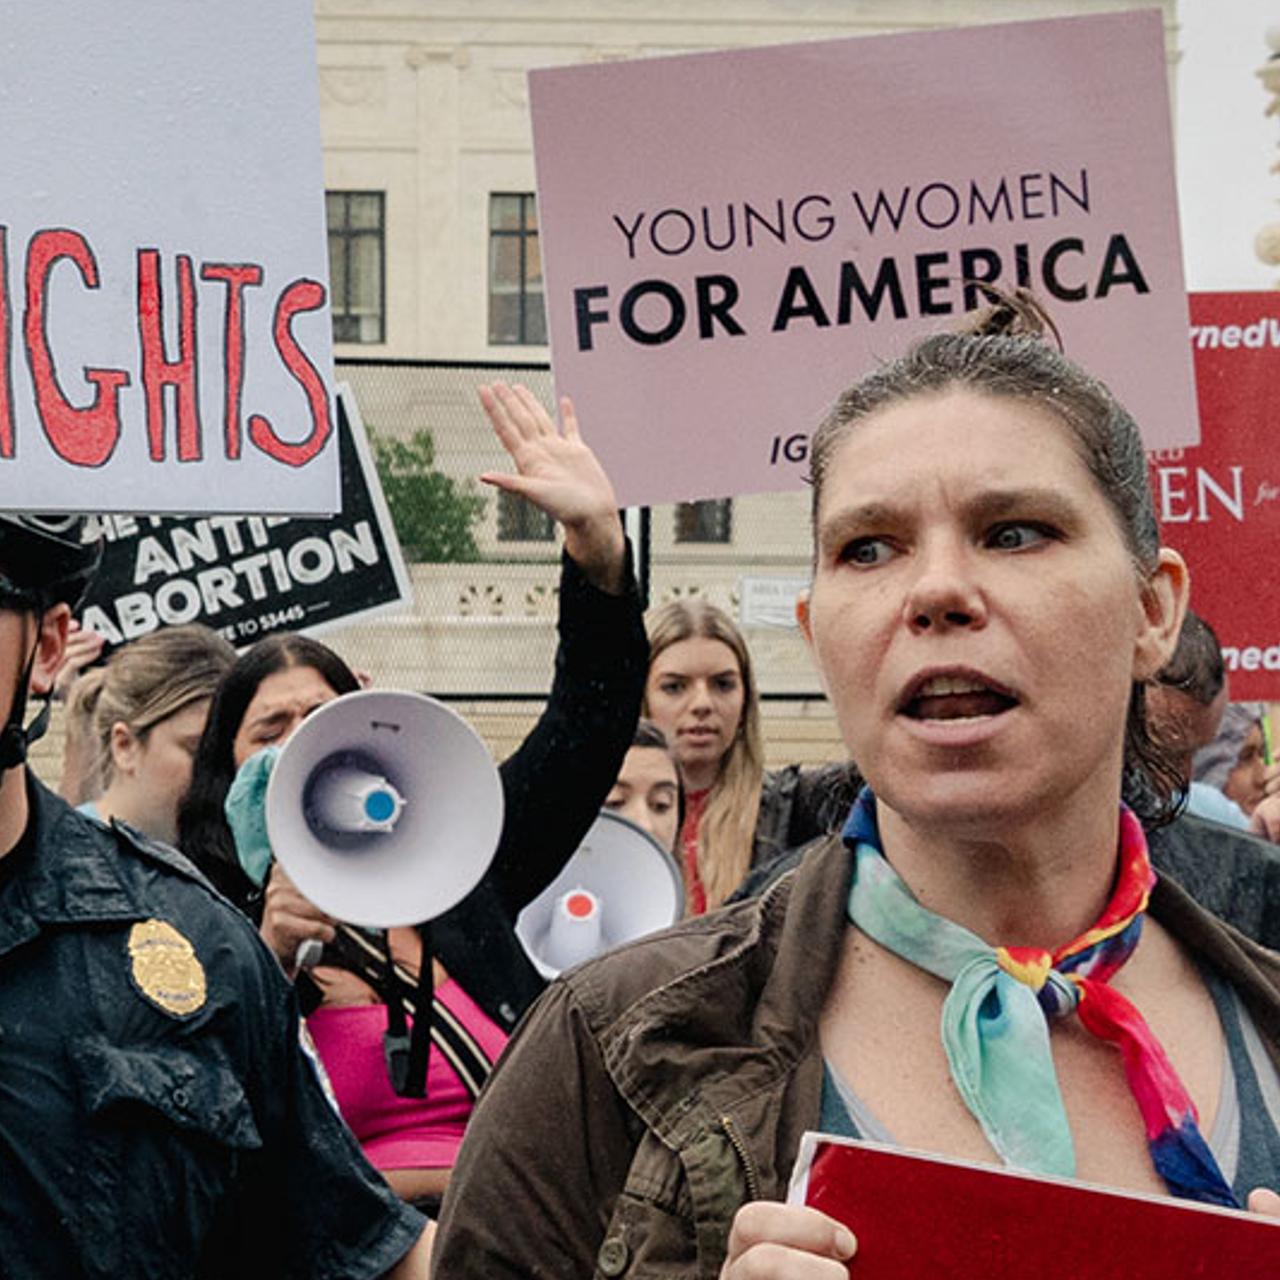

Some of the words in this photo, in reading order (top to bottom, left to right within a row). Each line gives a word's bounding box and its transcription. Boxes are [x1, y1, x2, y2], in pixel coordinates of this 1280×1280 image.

[612, 195, 836, 259] YOUNG
[852, 168, 1091, 234] WOMEN
[572, 273, 747, 352] FOR
[772, 233, 1151, 334] AMERICA
[80, 521, 379, 646] ABORTION
